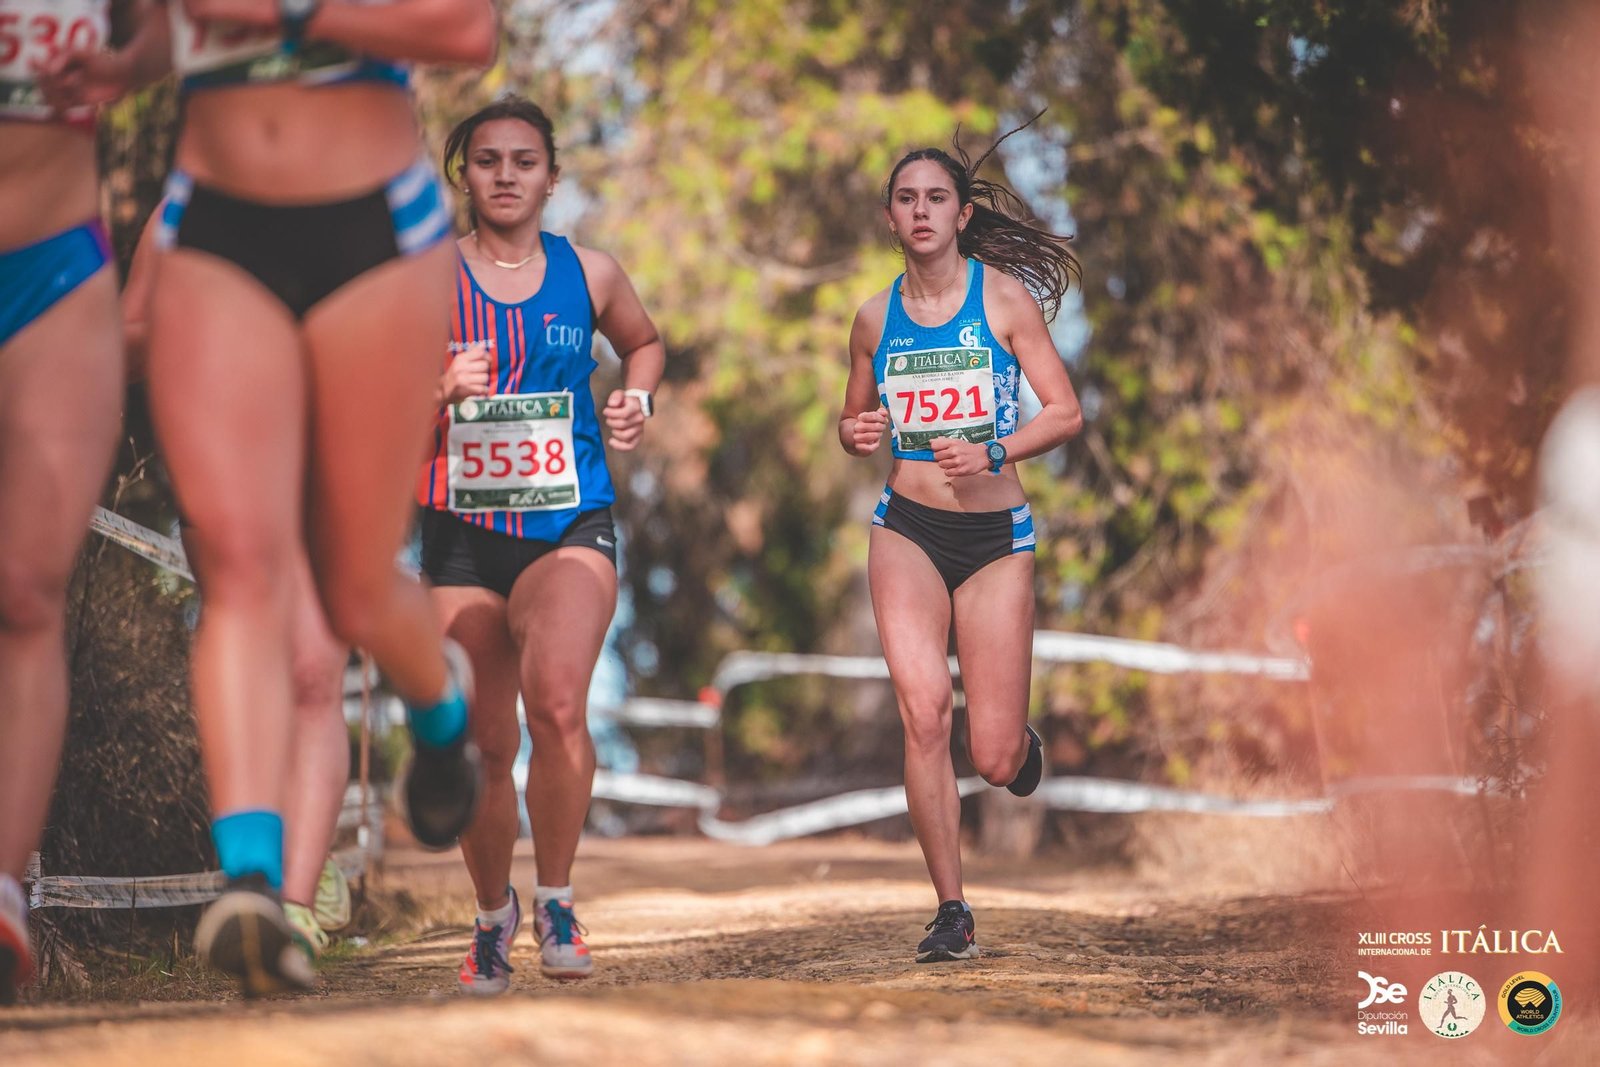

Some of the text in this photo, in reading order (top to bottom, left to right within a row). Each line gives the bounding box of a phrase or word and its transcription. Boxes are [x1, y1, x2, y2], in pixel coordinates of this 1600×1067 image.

[889, 336, 914, 347] vive
[914, 353, 962, 367] ITÁLICA
[484, 397, 544, 415] ITÁLICA
[896, 385, 988, 423] 7521
[461, 438, 566, 479] 5538
